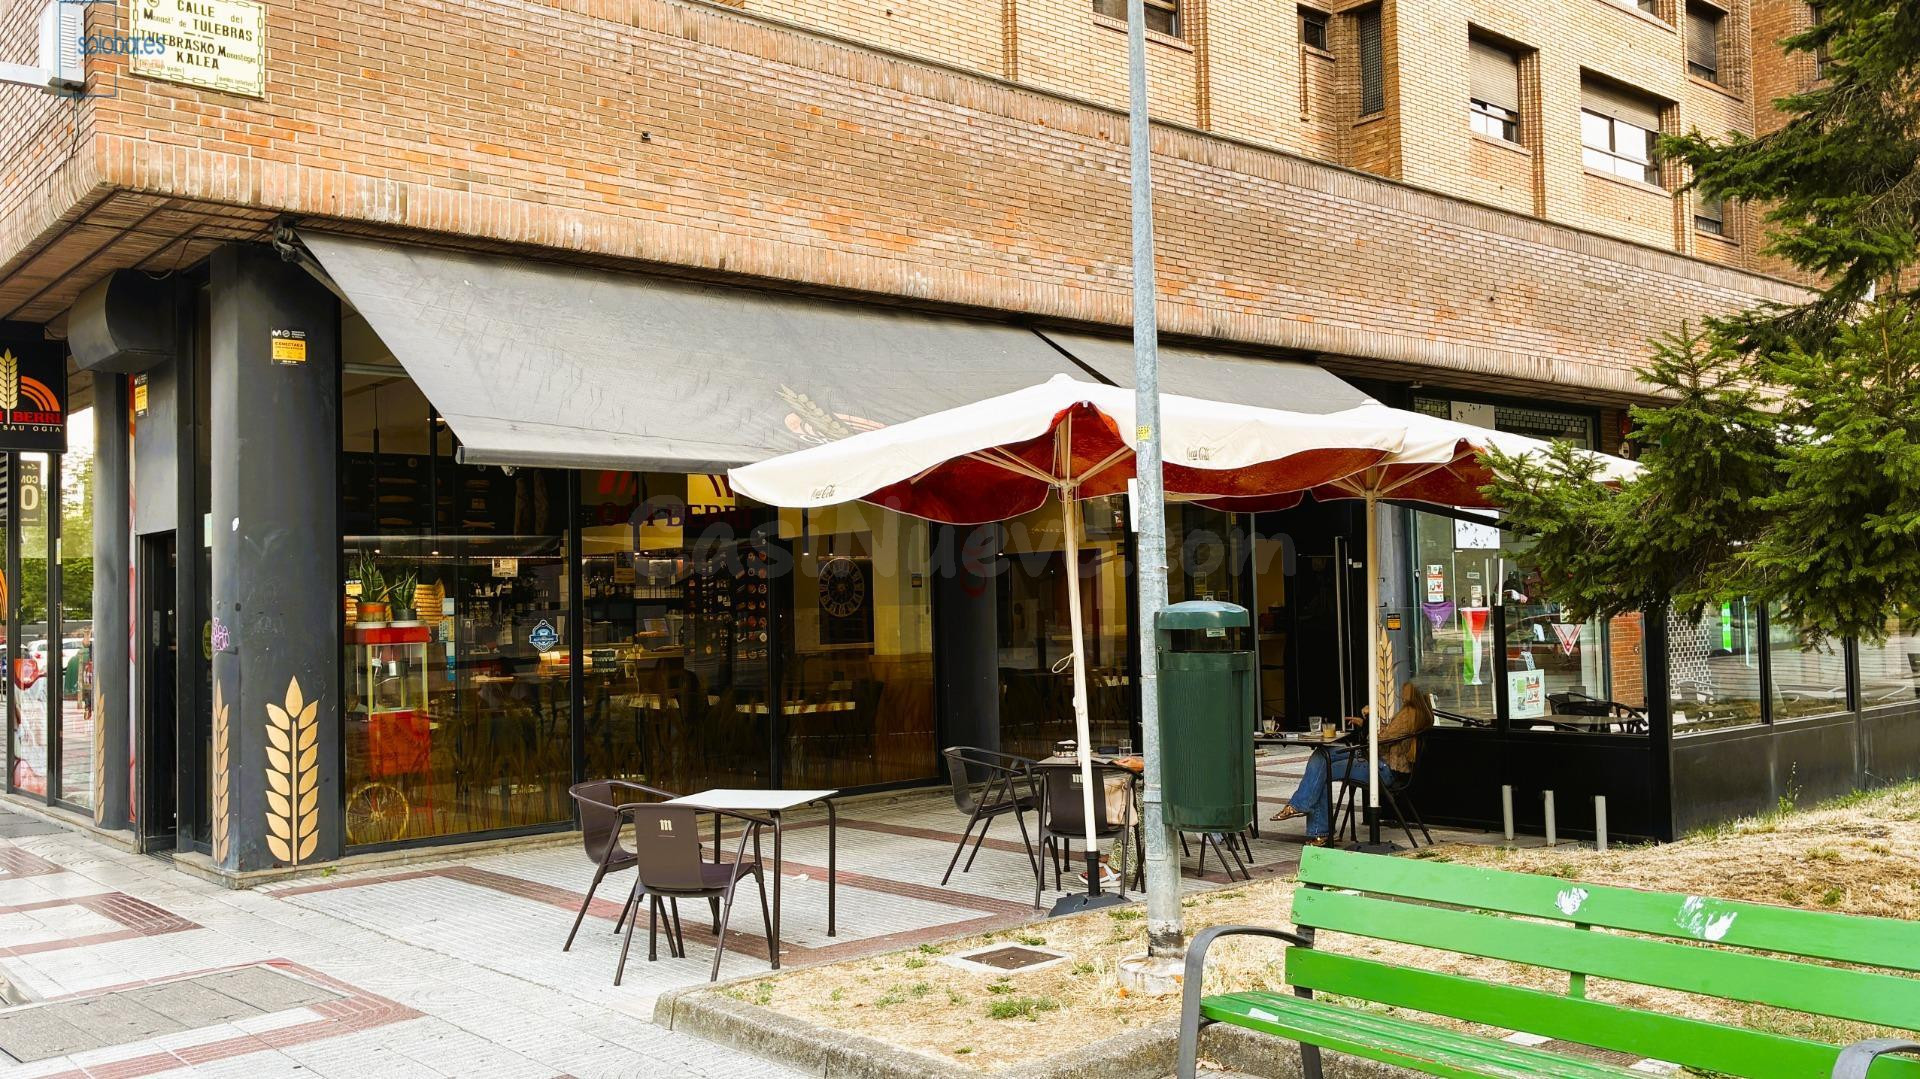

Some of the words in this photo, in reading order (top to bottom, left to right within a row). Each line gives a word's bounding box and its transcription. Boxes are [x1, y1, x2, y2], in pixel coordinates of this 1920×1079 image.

[177, 0, 215, 17] CALLE
[230, 14, 243, 24] del
[179, 20, 187, 28] de
[193, 18, 253, 42] TULEBRAS
[176, 51, 220, 70] KALEA
[13, 410, 62, 423] BERRI
[33, 425, 61, 433] OGIA
